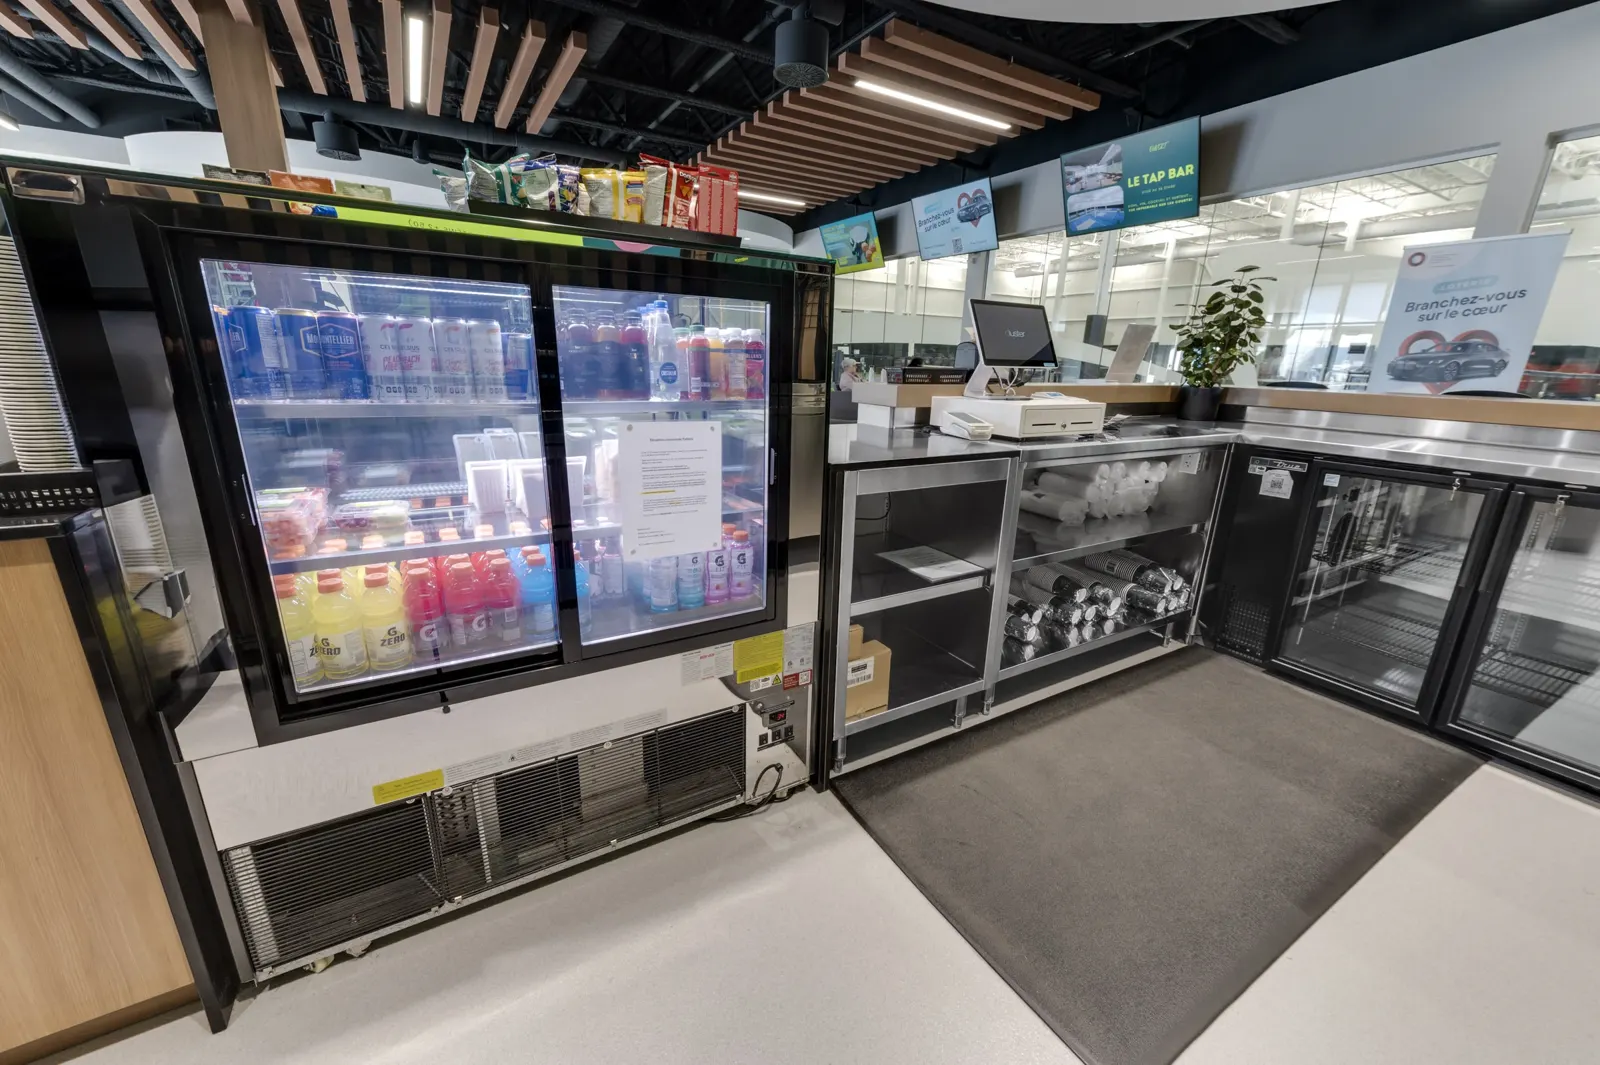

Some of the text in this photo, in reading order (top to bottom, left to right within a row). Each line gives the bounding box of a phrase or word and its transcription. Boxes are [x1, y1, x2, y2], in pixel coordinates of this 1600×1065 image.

[1127, 164, 1194, 188] LE TAP BAR
[918, 207, 954, 228] Branchez-vous
[924, 217, 951, 233] sur le cœur
[1405, 288, 1528, 313] Branchez-vous
[1417, 303, 1508, 322] sur le cœur
[691, 556, 698, 564] G
[714, 555, 725, 567] G
[736, 552, 747, 565] G
[387, 626, 398, 637] G
[419, 623, 438, 642] G
[321, 637, 330, 647] G
[380, 632, 406, 647] ZERO
